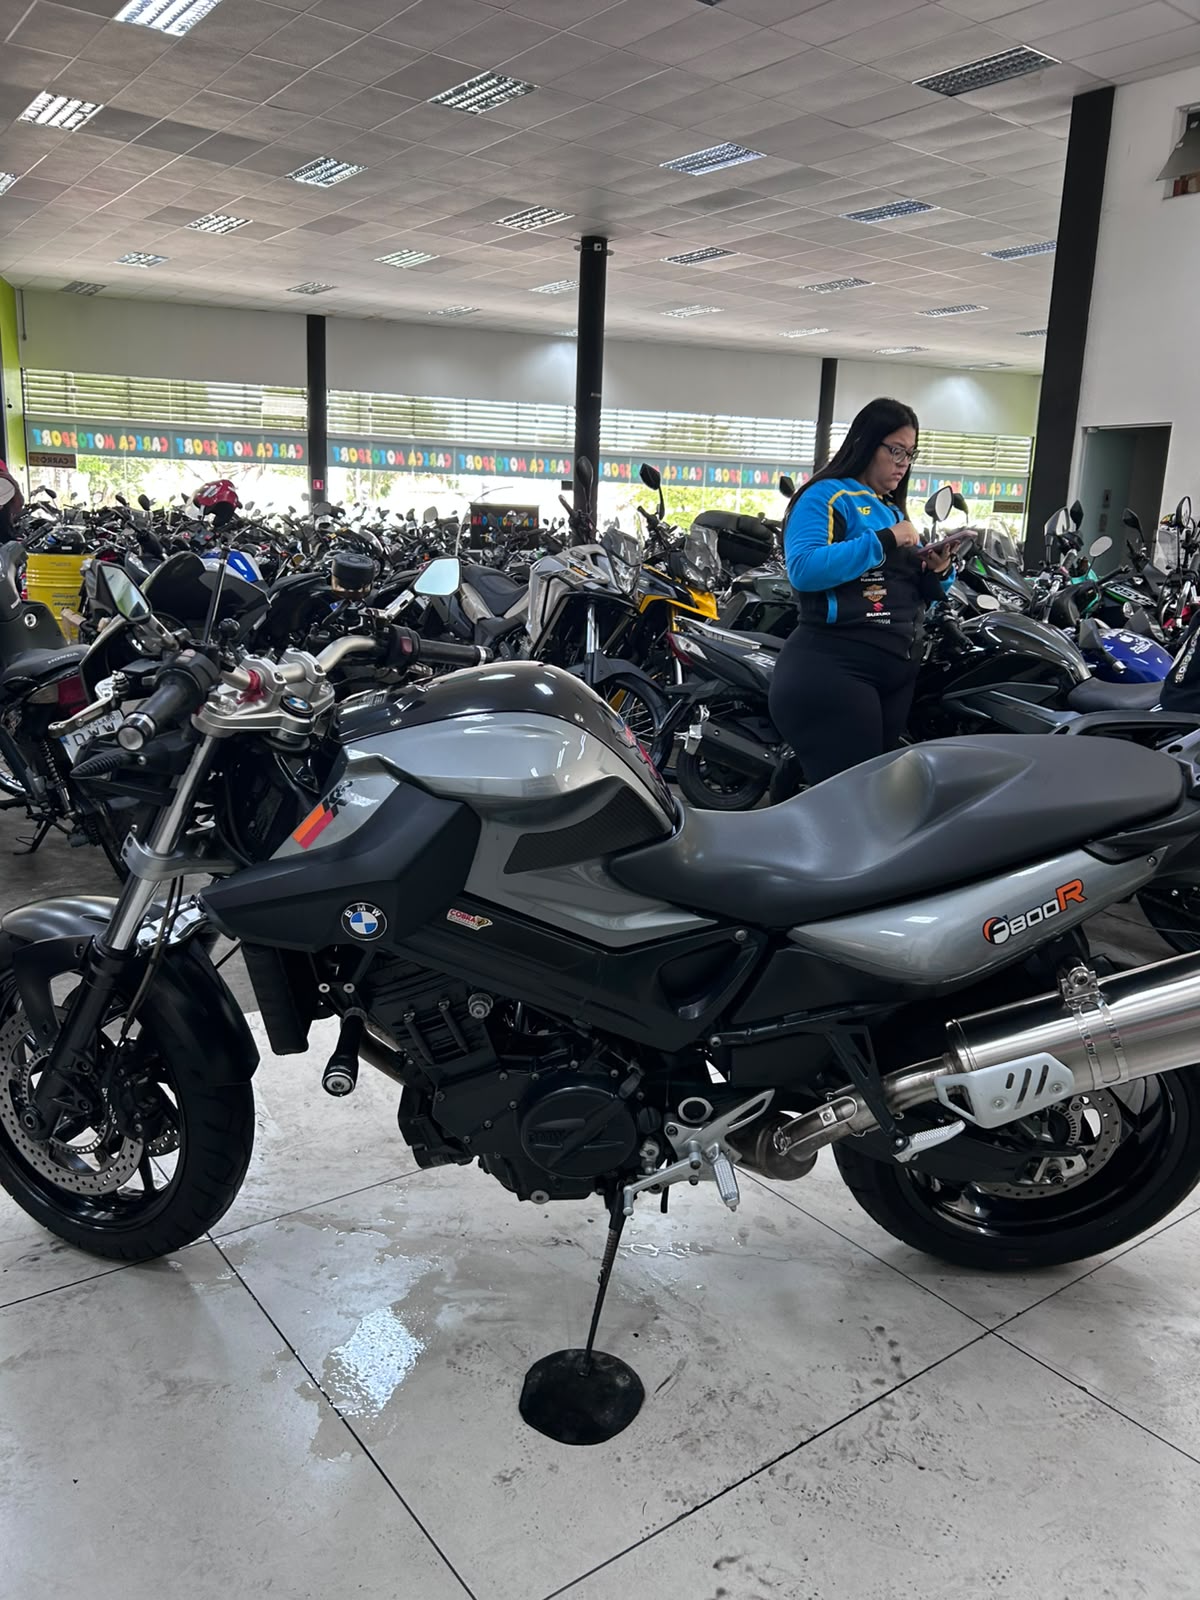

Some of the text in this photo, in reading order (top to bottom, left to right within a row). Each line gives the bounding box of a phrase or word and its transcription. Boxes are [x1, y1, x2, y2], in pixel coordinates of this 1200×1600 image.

[47, 652, 79, 664] HONDA
[344, 904, 382, 919] BMW
[449, 909, 476, 924] COBRA
